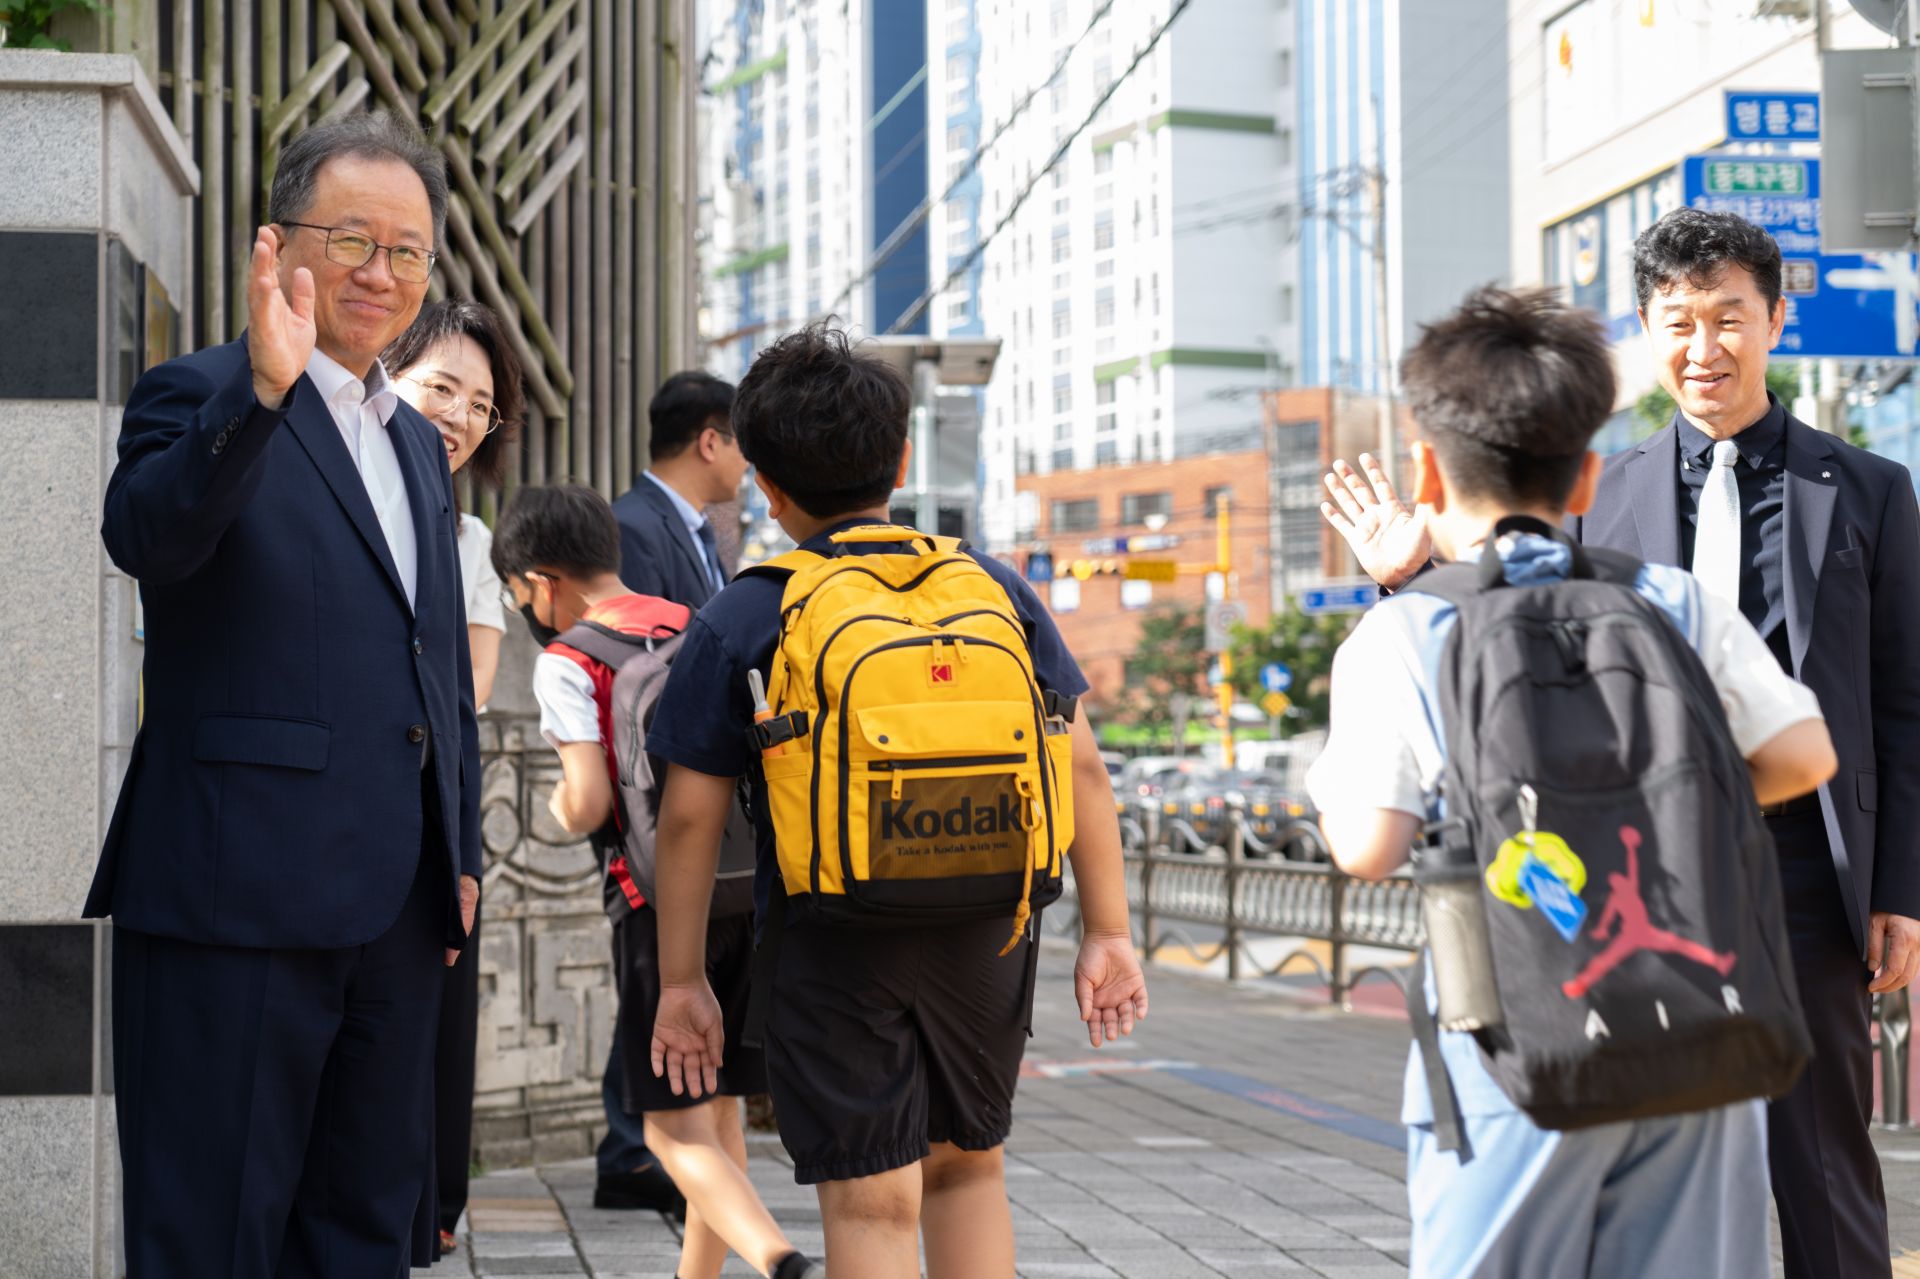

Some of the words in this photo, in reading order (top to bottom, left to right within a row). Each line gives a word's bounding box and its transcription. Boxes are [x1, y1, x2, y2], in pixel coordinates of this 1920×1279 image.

[881, 793, 1023, 840] Kodak
[896, 846, 921, 856] Take
[969, 842, 991, 852] with
[1585, 984, 1744, 1041] AIR
